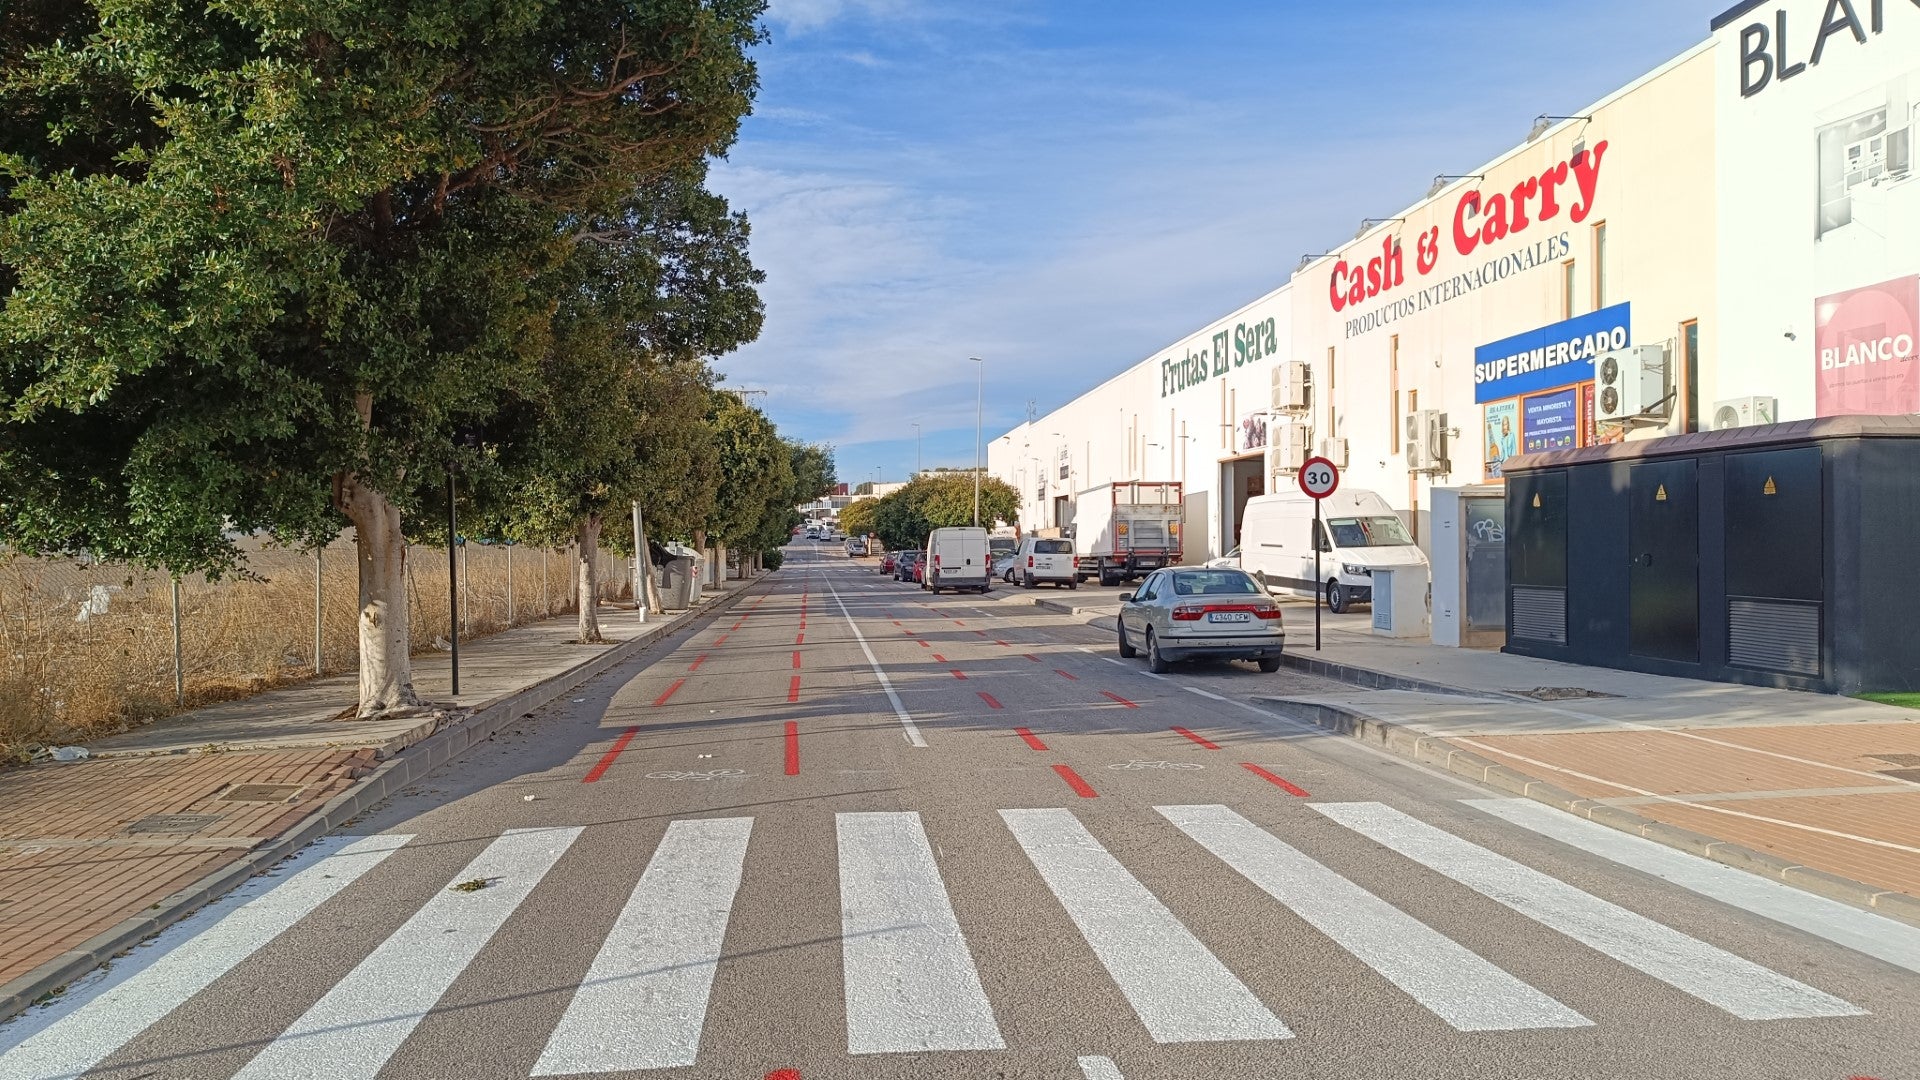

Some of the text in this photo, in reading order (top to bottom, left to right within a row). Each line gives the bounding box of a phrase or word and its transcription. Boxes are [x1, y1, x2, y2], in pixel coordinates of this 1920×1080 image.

[1330, 140, 1608, 312] Cash & Carry
[1346, 231, 1569, 339] PRODUCTOS INTERNACIONALES
[1161, 317, 1277, 398] Frutas El Sera
[1475, 326, 1626, 384] SUPERMERCADO
[1821, 334, 1913, 371] BLANCO
[1528, 405, 1542, 414] VENTA
[1543, 401, 1567, 411] MINORISTA
[1536, 415, 1562, 425] MAYORISTA
[1308, 471, 1330, 485] 30
